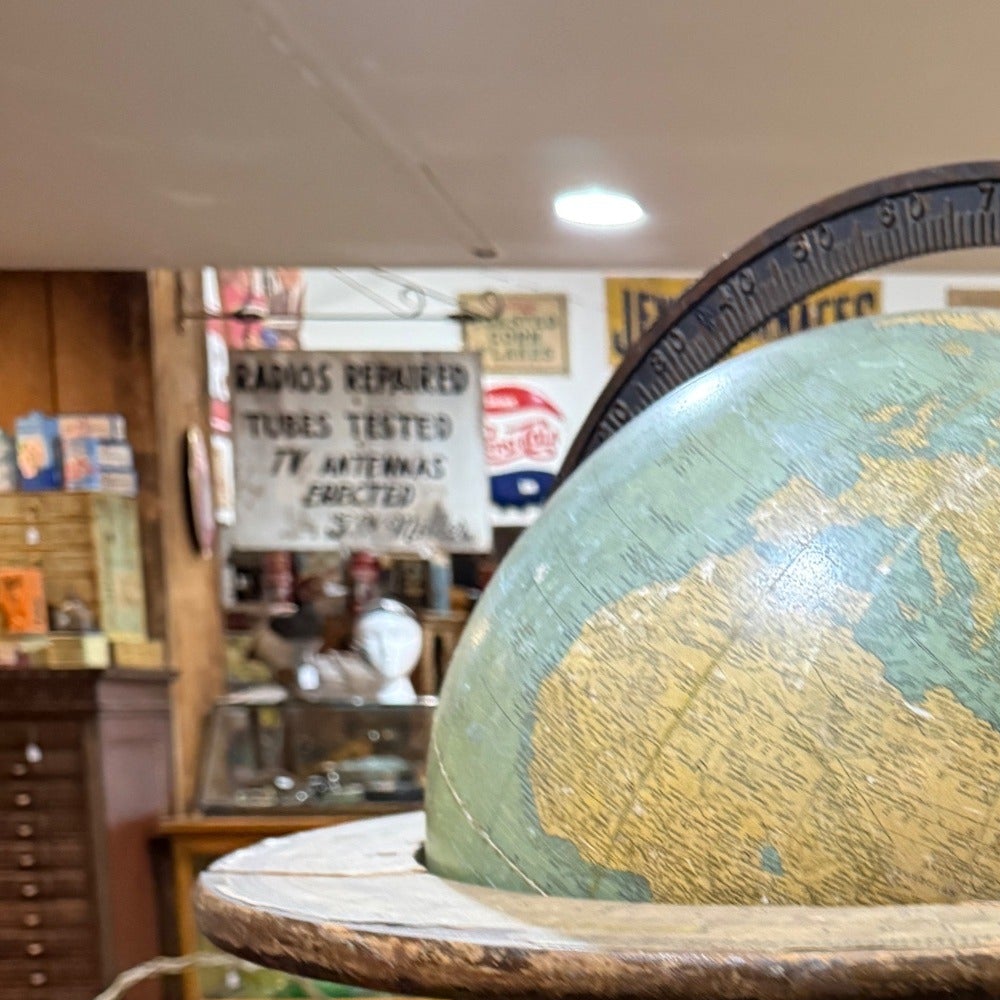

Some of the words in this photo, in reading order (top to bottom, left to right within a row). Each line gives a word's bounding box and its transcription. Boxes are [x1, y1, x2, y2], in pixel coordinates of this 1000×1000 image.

[234, 362, 334, 394] RADIOS
[343, 362, 470, 396] REPAIRED
[243, 413, 333, 440] TUBES
[346, 412, 454, 441] TESTED
[270, 449, 312, 477] TV
[322, 455, 447, 481] ANTENNAS
[303, 484, 416, 509] ERECTED
